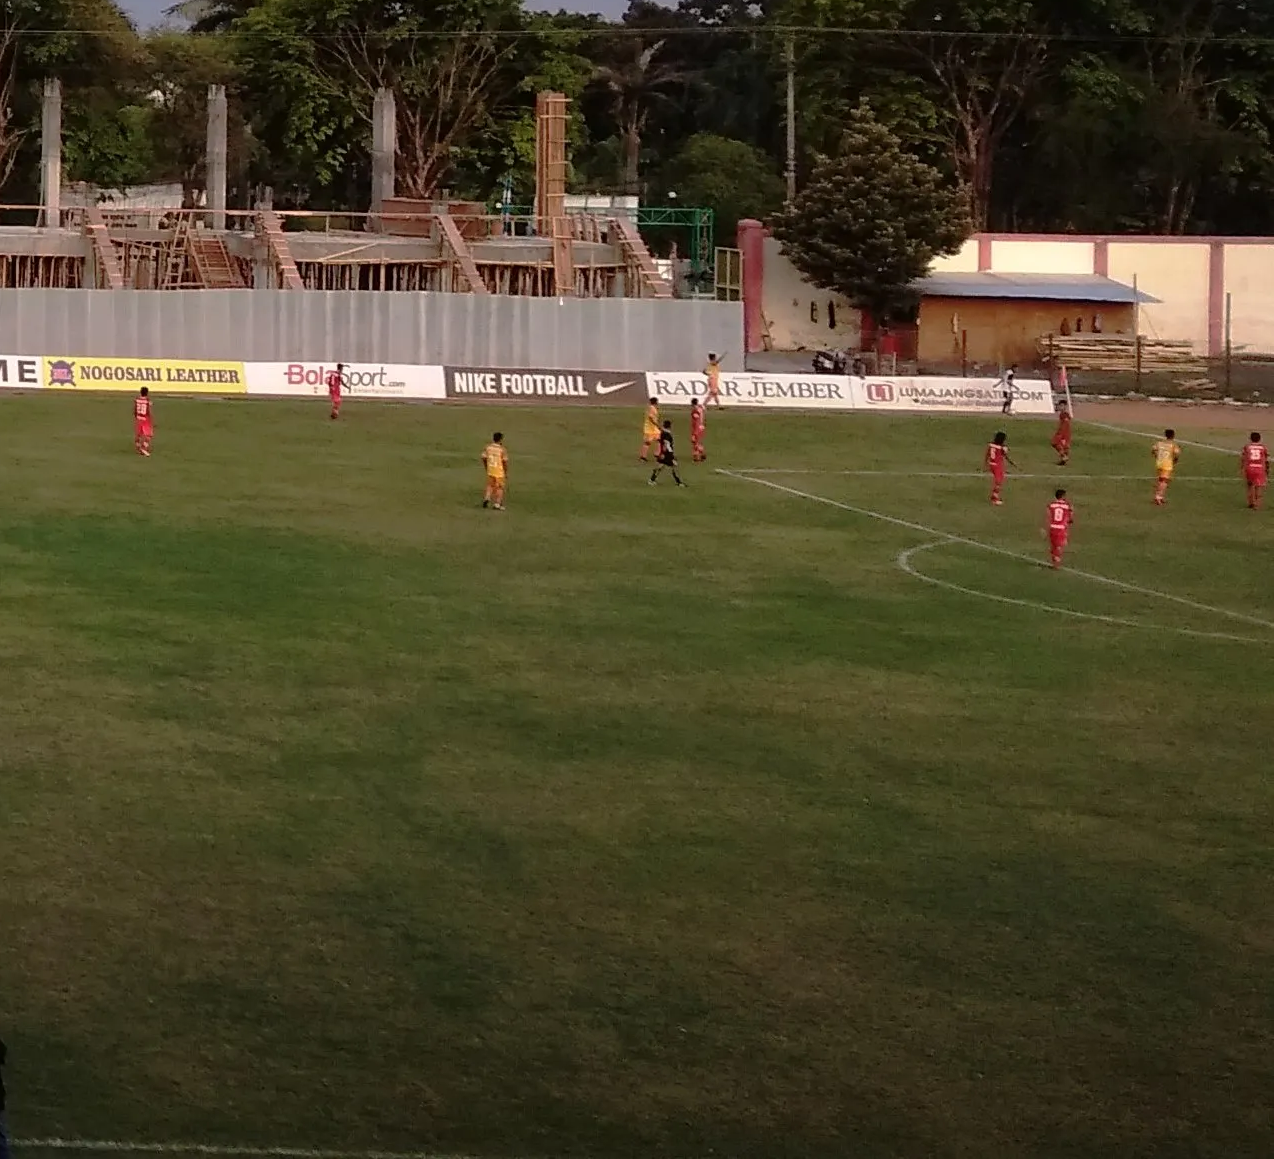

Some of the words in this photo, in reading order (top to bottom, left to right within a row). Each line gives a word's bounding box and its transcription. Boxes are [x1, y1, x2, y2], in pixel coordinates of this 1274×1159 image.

[80, 365, 162, 382] NOGOSARI
[167, 368, 240, 384] LEATHER
[453, 371, 497, 395] NIKE
[500, 373, 589, 397] FOOTBALL
[747, 381, 844, 399] JEMBER
[900, 387, 1043, 401] LUMAJANGSATUCOM
